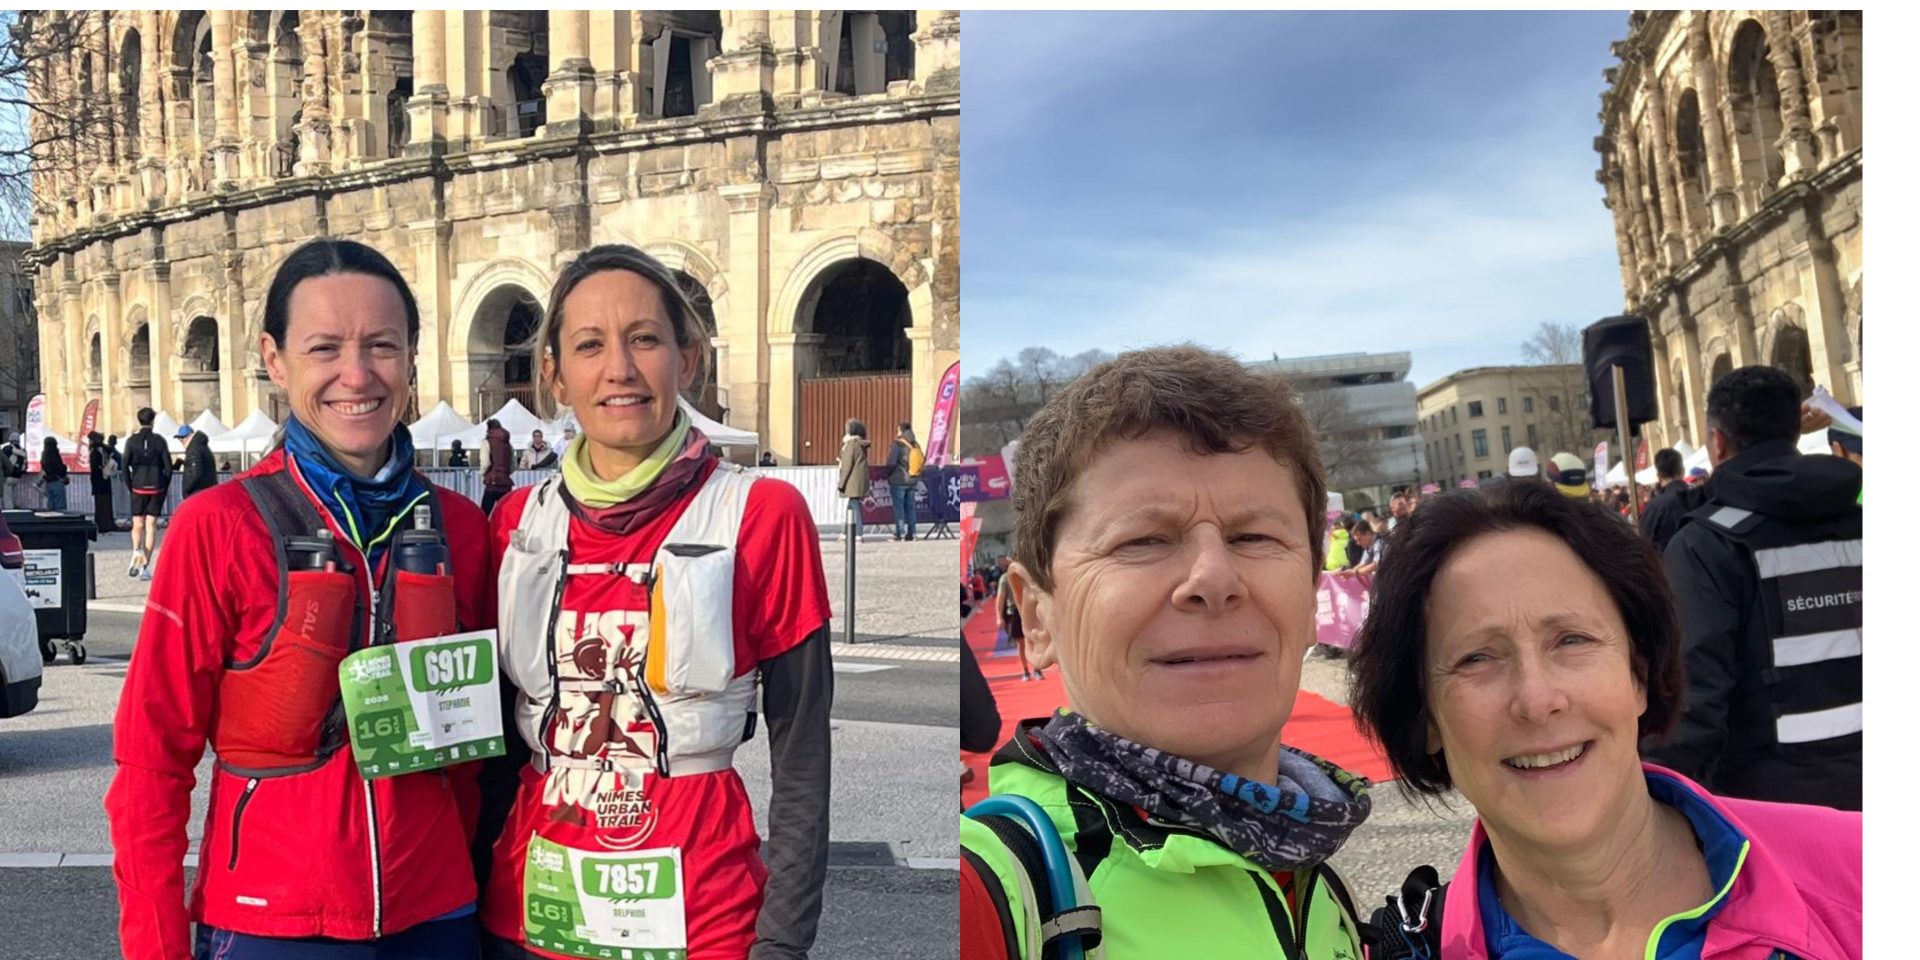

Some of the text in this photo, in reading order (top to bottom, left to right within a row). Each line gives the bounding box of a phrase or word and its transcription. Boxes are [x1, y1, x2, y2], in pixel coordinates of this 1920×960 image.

[1787, 590, 1854, 612] SÉCURITÉ
[301, 599, 319, 640] SAL
[424, 645, 478, 686] 6917
[358, 717, 393, 739] 16
[597, 802, 651, 815] URBAN
[599, 815, 643, 827] TRAIL
[595, 862, 659, 895] 7857
[530, 900, 561, 921] 16
